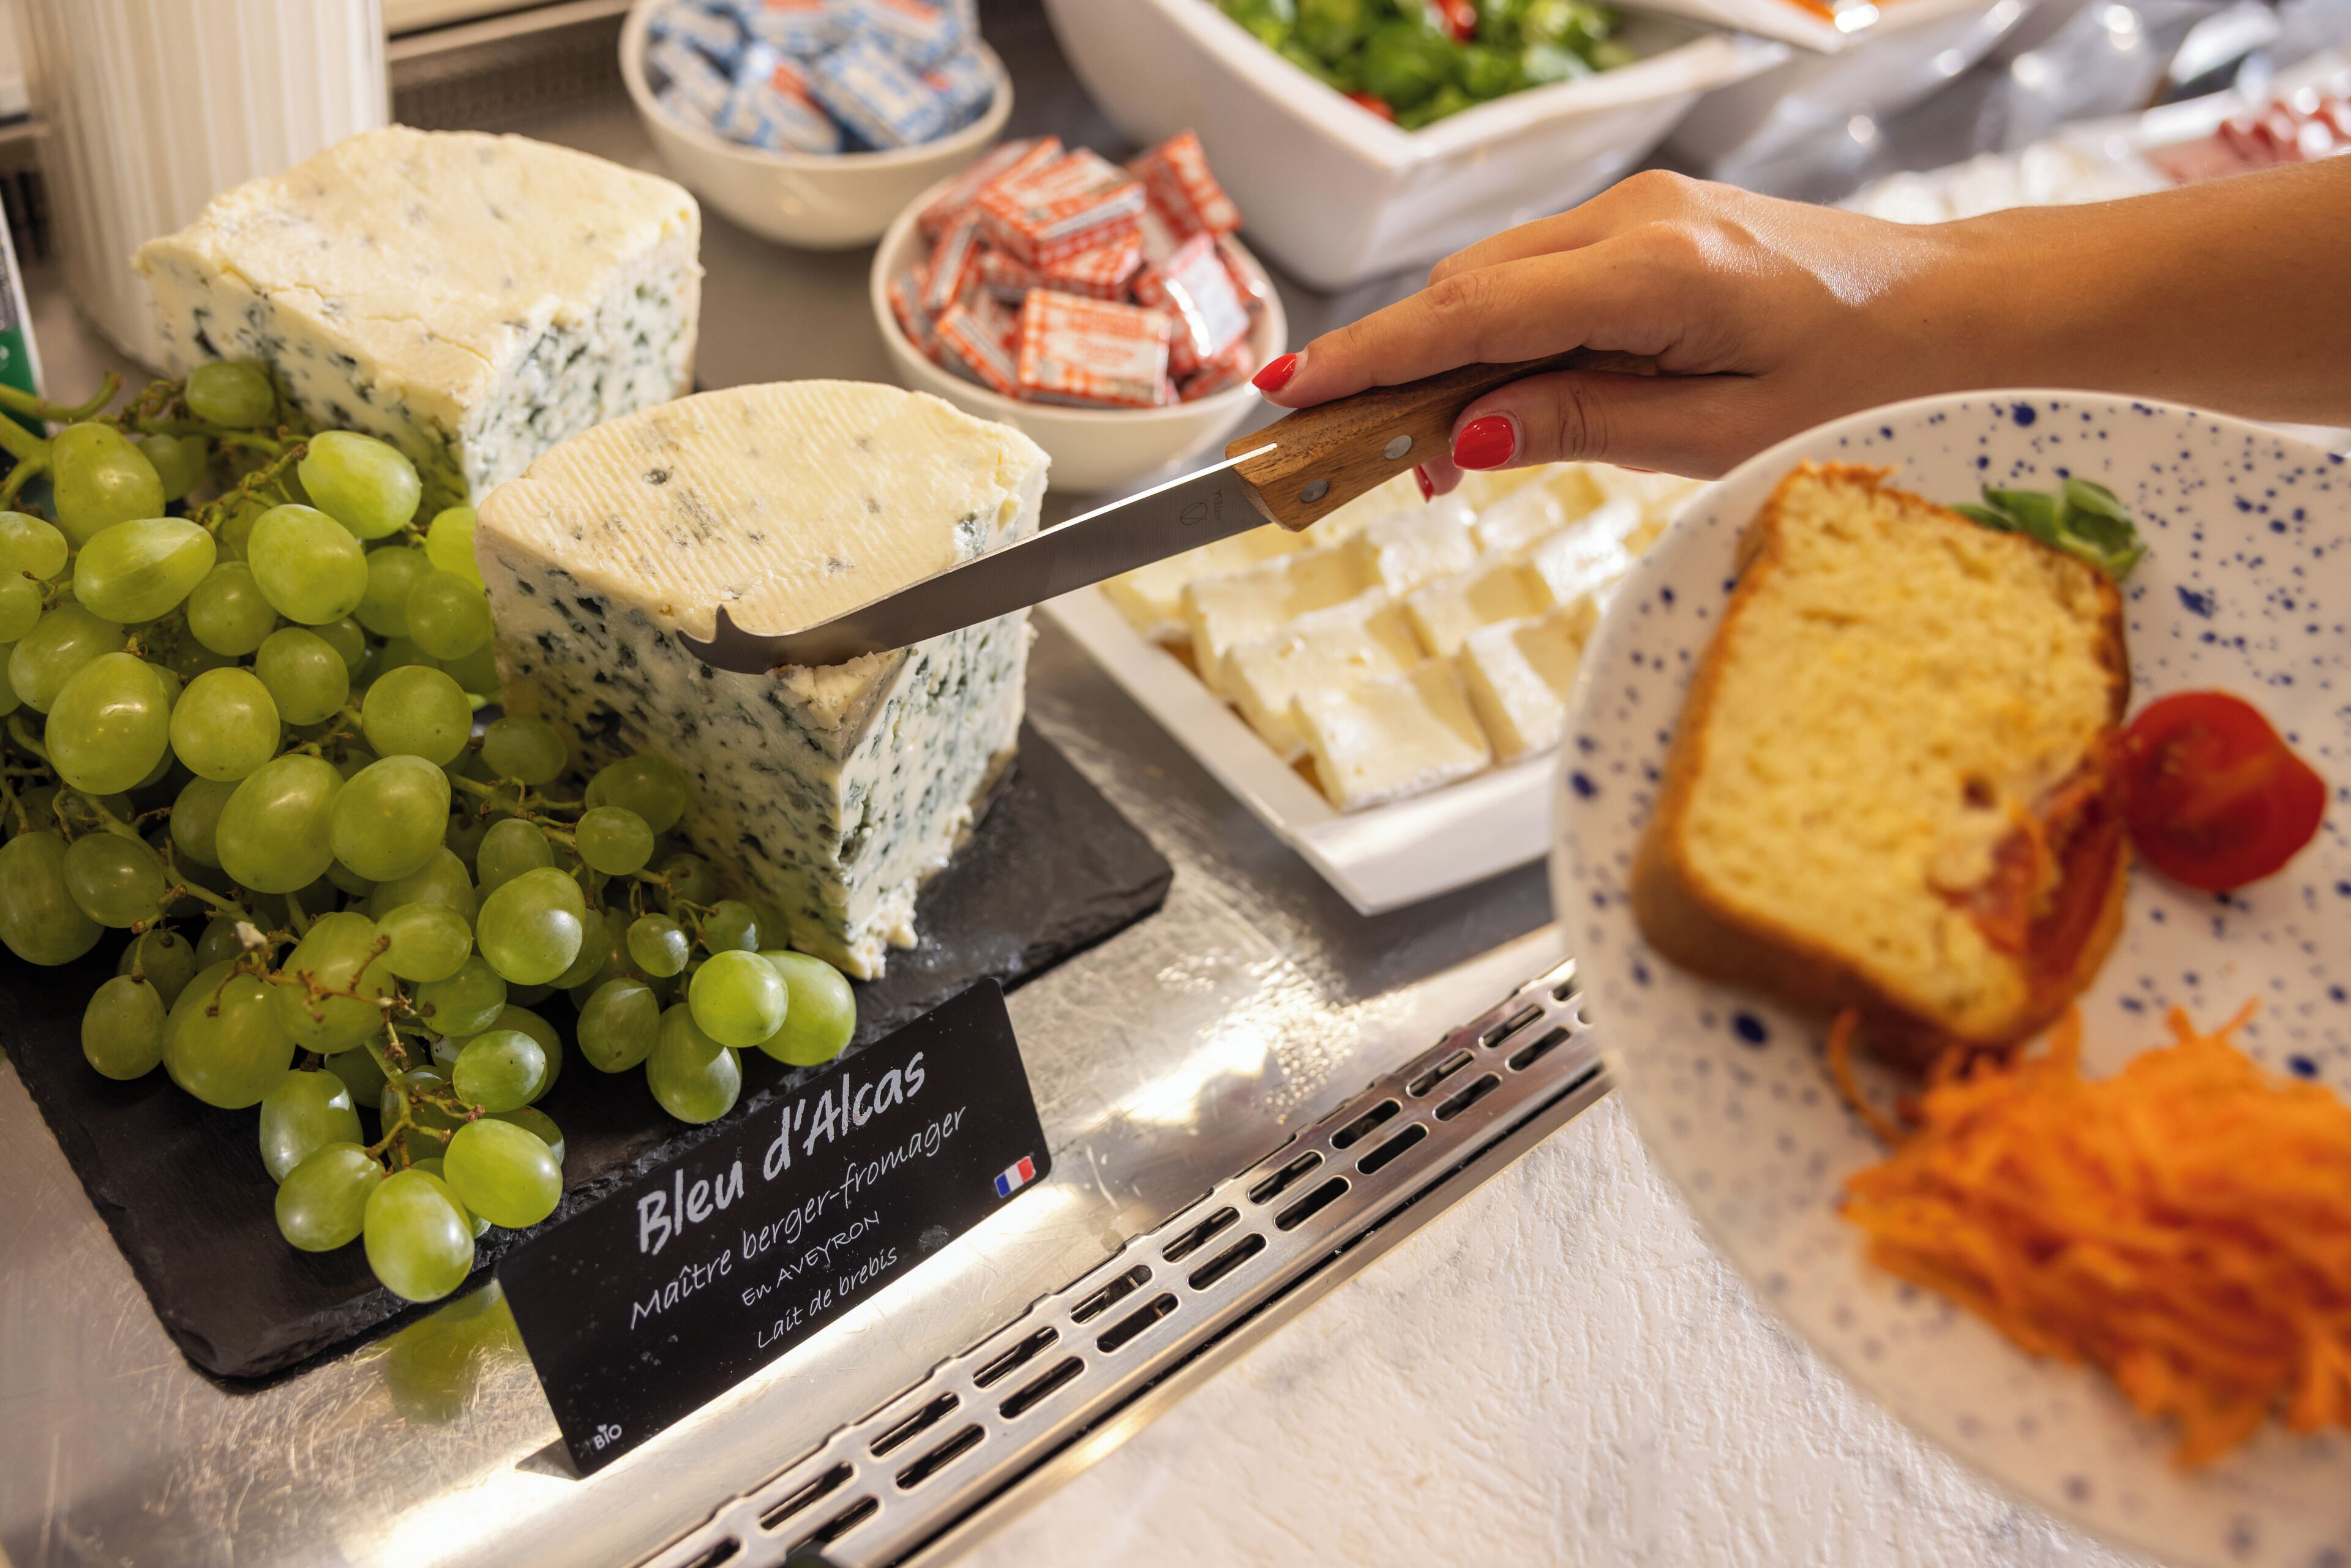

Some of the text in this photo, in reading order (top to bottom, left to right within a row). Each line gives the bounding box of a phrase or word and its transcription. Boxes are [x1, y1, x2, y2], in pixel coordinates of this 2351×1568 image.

[631, 1106, 967, 1330] Maître berger-fromager
[637, 1052, 925, 1255] Bleu d'Alcas
[741, 1210, 880, 1307] En AVEYRON
[758, 1247, 898, 1349] Lait de brebis
